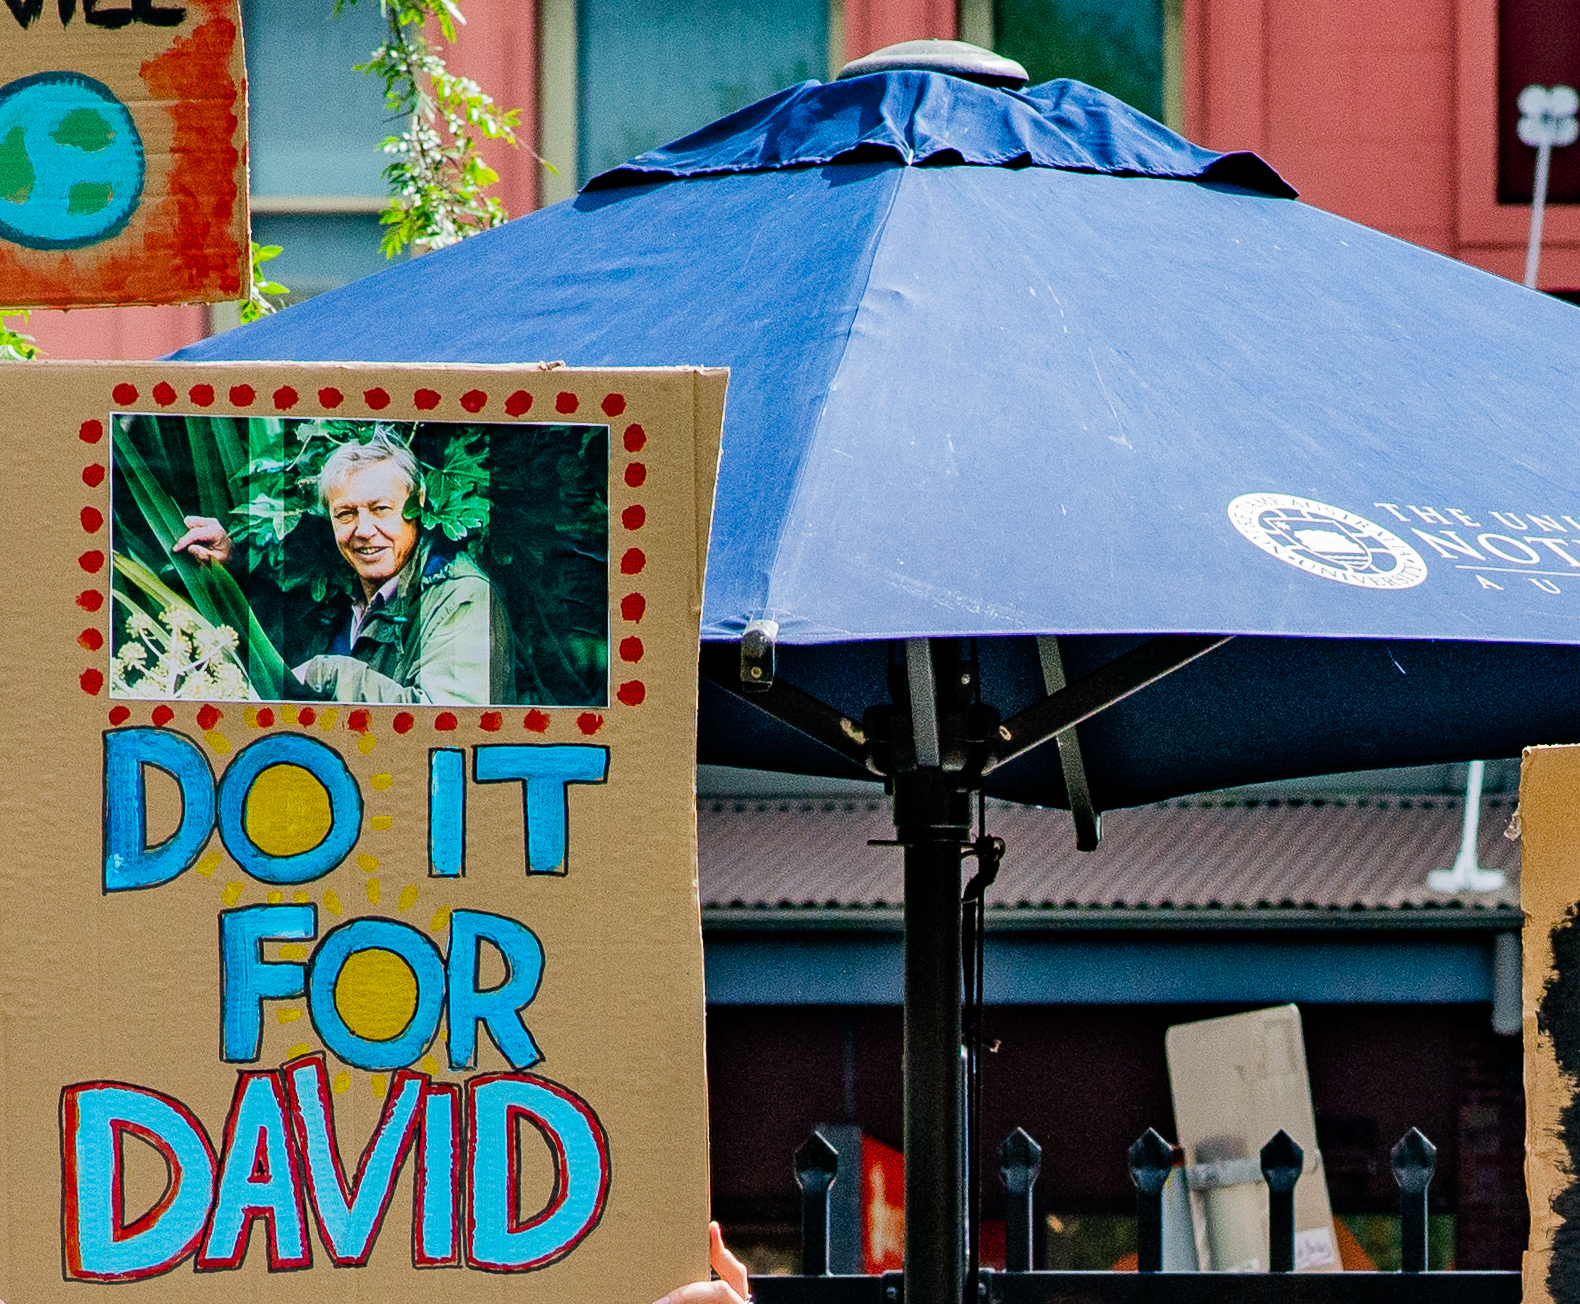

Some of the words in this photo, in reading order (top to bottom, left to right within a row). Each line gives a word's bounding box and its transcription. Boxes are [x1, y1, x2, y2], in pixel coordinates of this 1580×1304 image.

[1373, 502, 1483, 530] THE
[102, 727, 364, 894] DO
[425, 742, 611, 878] IT
[219, 902, 546, 1072] FOR
[60, 1053, 611, 1282] DAVID
